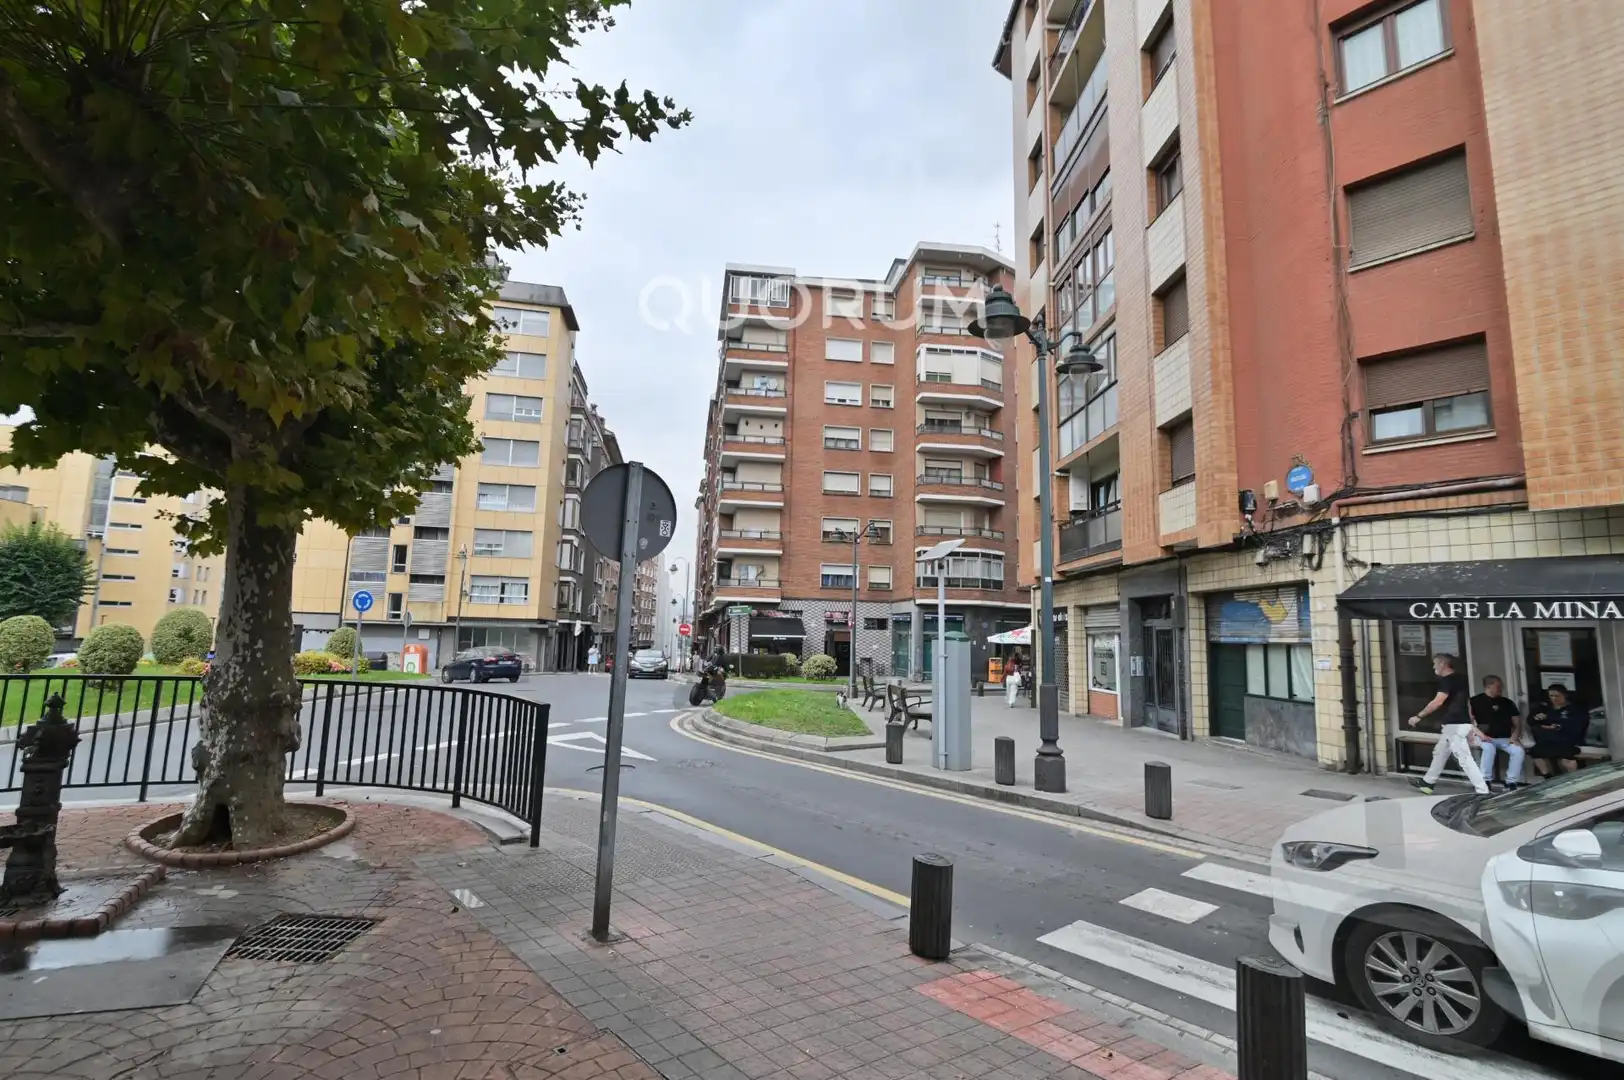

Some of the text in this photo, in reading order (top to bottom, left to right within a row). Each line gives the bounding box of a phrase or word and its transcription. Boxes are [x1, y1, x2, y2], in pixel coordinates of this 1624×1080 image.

[1409, 601, 1624, 619] CAFE LA MINA
